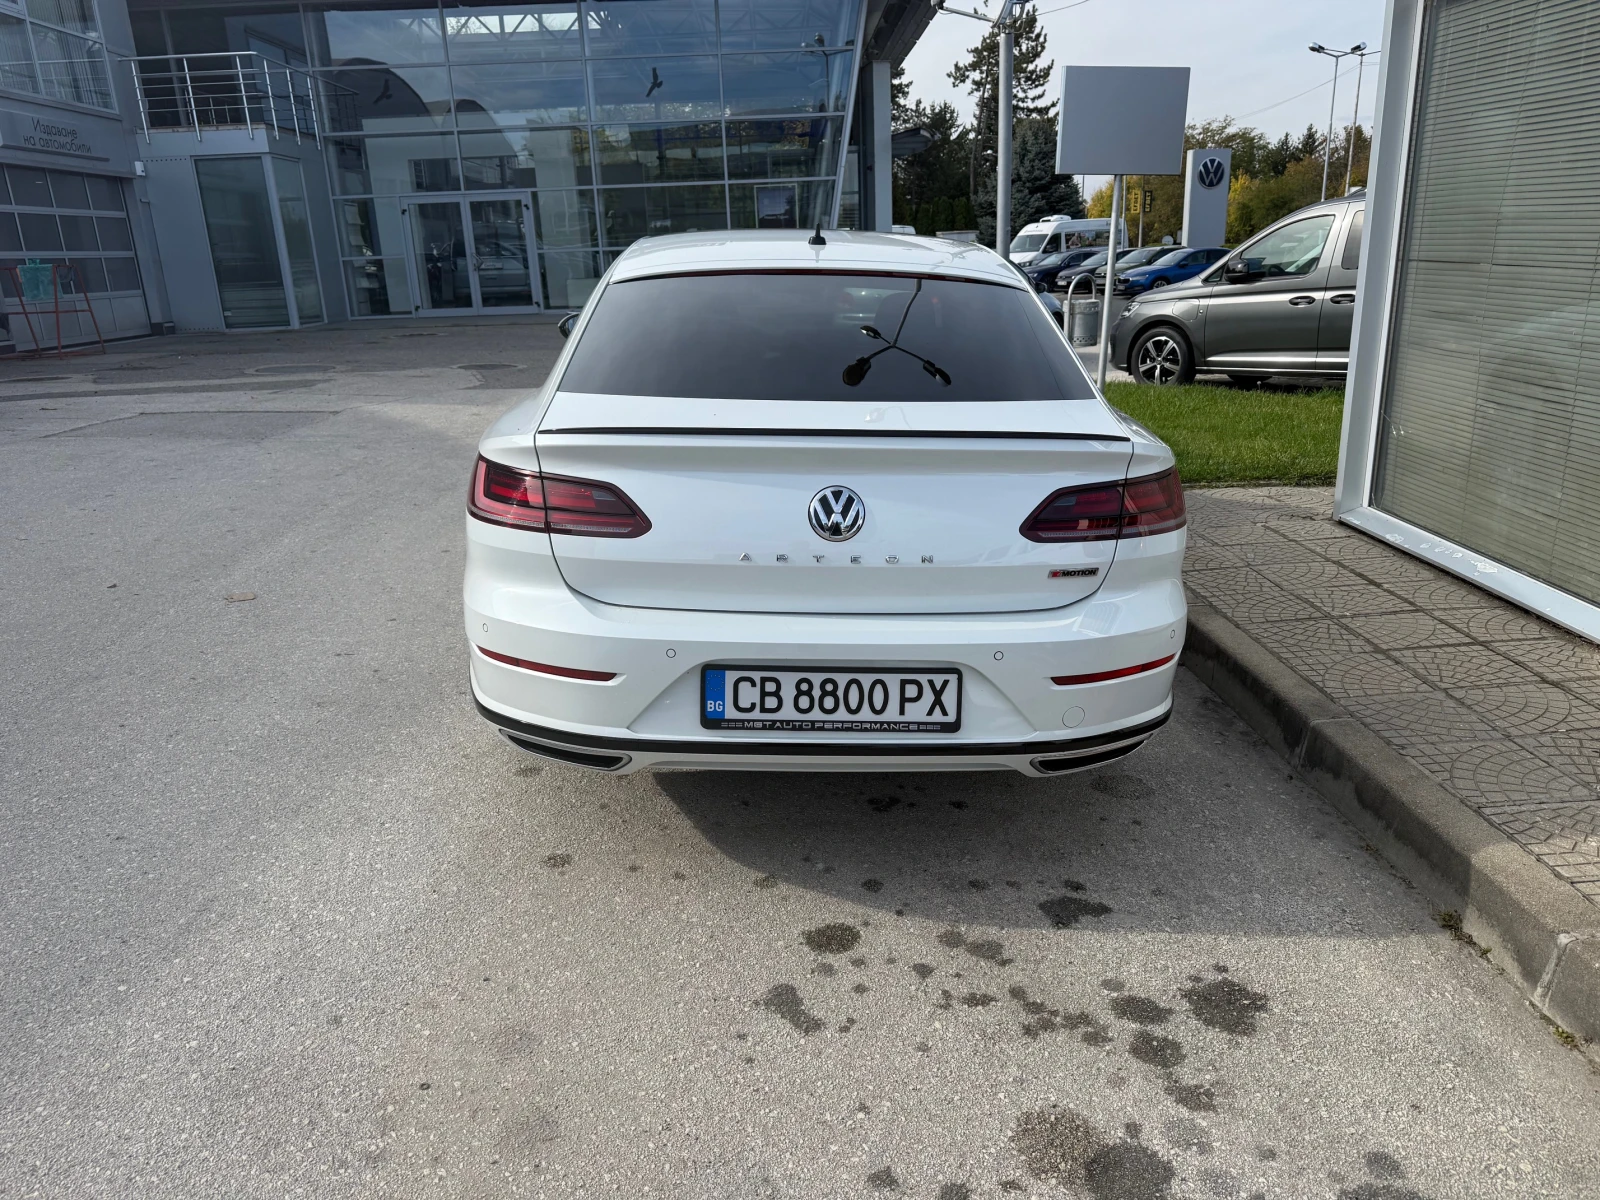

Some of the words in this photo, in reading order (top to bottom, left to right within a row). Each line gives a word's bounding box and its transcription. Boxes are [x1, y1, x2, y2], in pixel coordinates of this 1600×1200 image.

[32, 117, 78, 139] Издаване
[23, 135, 36, 146] на
[39, 137, 92, 154] автомобили
[739, 552, 934, 564] ARTEON
[707, 701, 723, 712] BG
[733, 676, 783, 714] CB
[793, 677, 889, 716] 8800
[898, 679, 950, 717] PX
[774, 721, 811, 729] AUTO
[814, 722, 918, 731] PERFORMANCE
